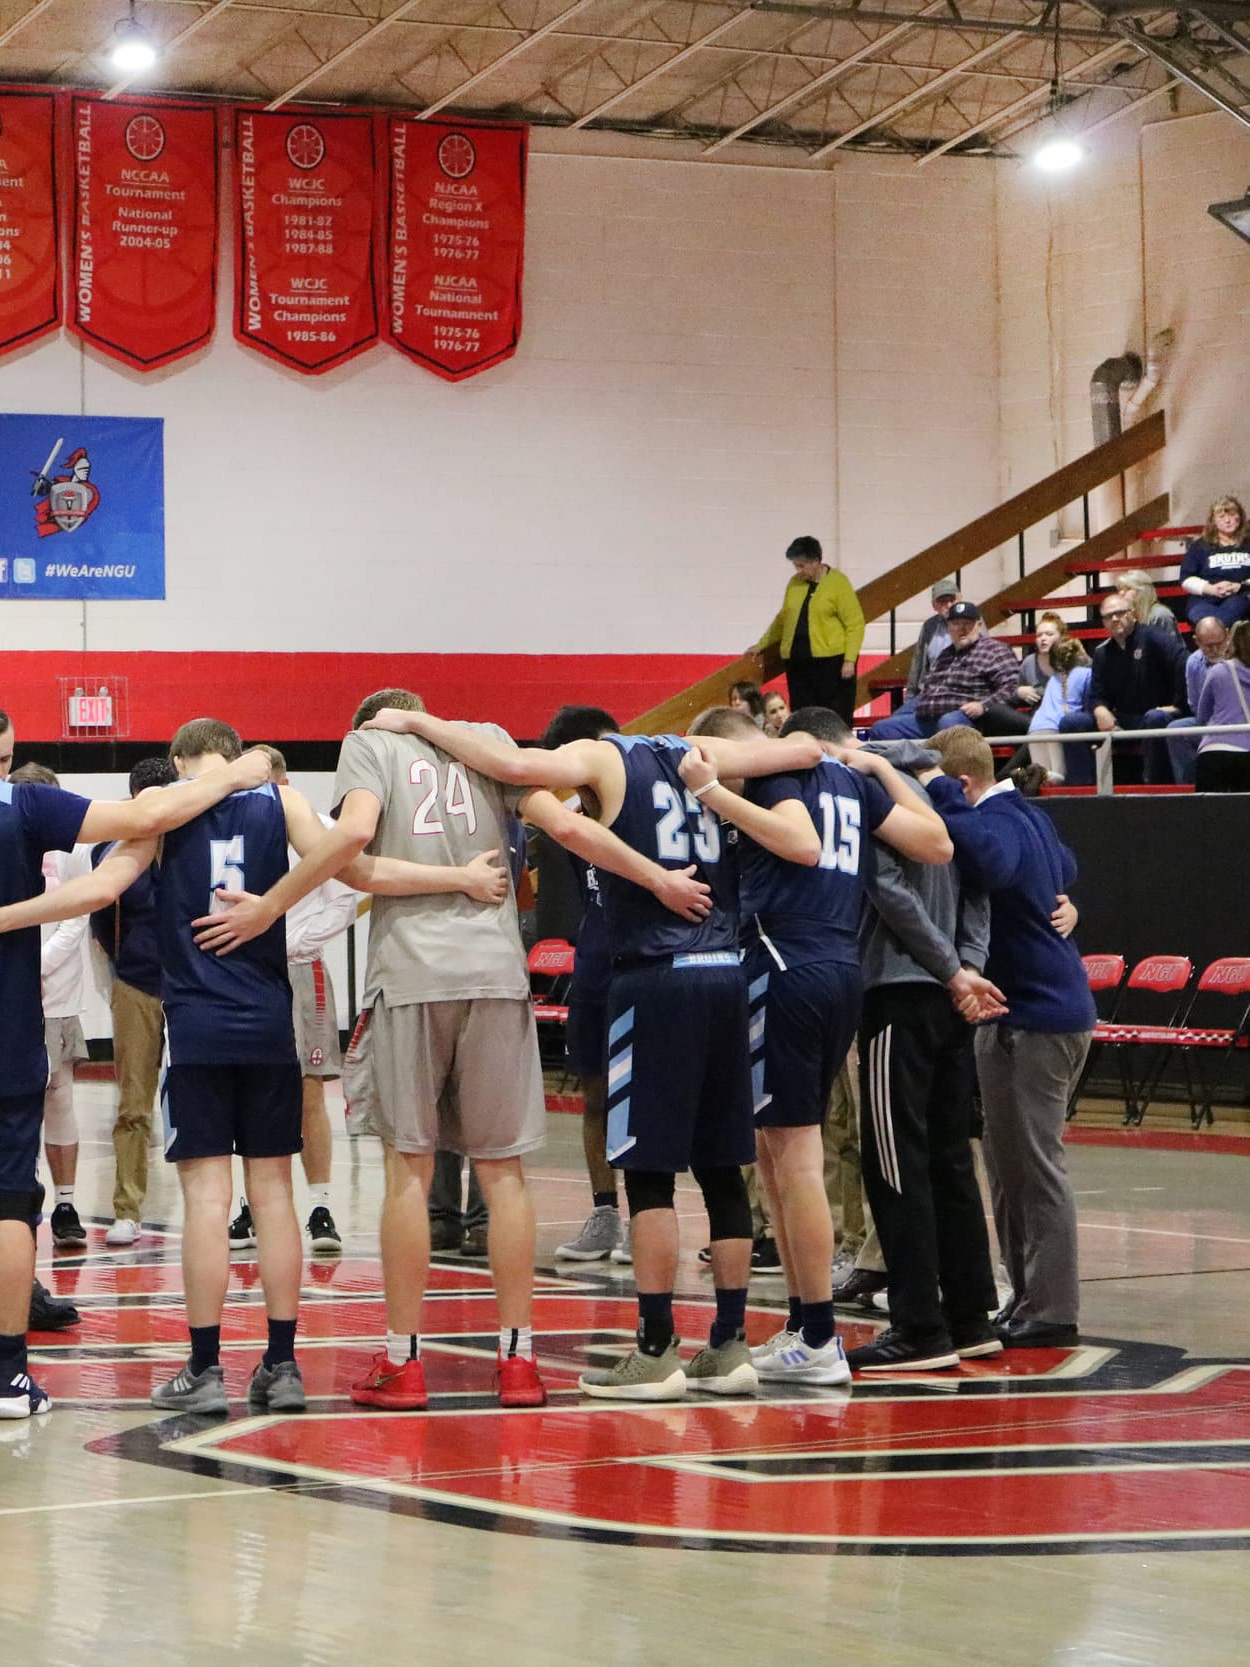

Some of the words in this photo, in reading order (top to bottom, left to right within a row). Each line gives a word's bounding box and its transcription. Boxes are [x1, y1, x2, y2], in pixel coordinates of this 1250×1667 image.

[78, 105, 91, 226] BASKETBALL
[121, 169, 170, 183] NCCAA
[241, 117, 255, 236] BASKETBALL
[393, 123, 407, 241] BASKETBALL
[289, 178, 326, 190] WCJC
[434, 182, 478, 195] NJCAA
[105, 184, 186, 200] Tournament
[271, 193, 342, 208] Champions
[429, 198, 472, 213] Region
[474, 202, 483, 212] X
[118, 207, 173, 220] National
[112, 220, 178, 238] Runner-up
[422, 213, 489, 230] Champions
[119, 235, 171, 249] 2004-05
[433, 233, 479, 247] 1975-76
[433, 247, 479, 260] 1976-77
[78, 232, 93, 322] WOMEN'S
[290, 278, 328, 289] WCJC
[434, 274, 477, 288] NJCAA
[391, 246, 408, 334] WOMEN'S
[429, 290, 482, 304] National
[269, 293, 350, 306] Tournament
[273, 310, 347, 325] Champions
[286, 331, 336, 342] 1985-86
[433, 325, 480, 338] 1975-76
[434, 339, 480, 352] 1976-77
[45, 564, 136, 578] #WeAreNGU
[79, 698, 108, 723] EXIT
[409, 758, 479, 836] 24
[651, 780, 722, 864] 23
[818, 791, 861, 876] 15
[209, 834, 245, 916] 5
